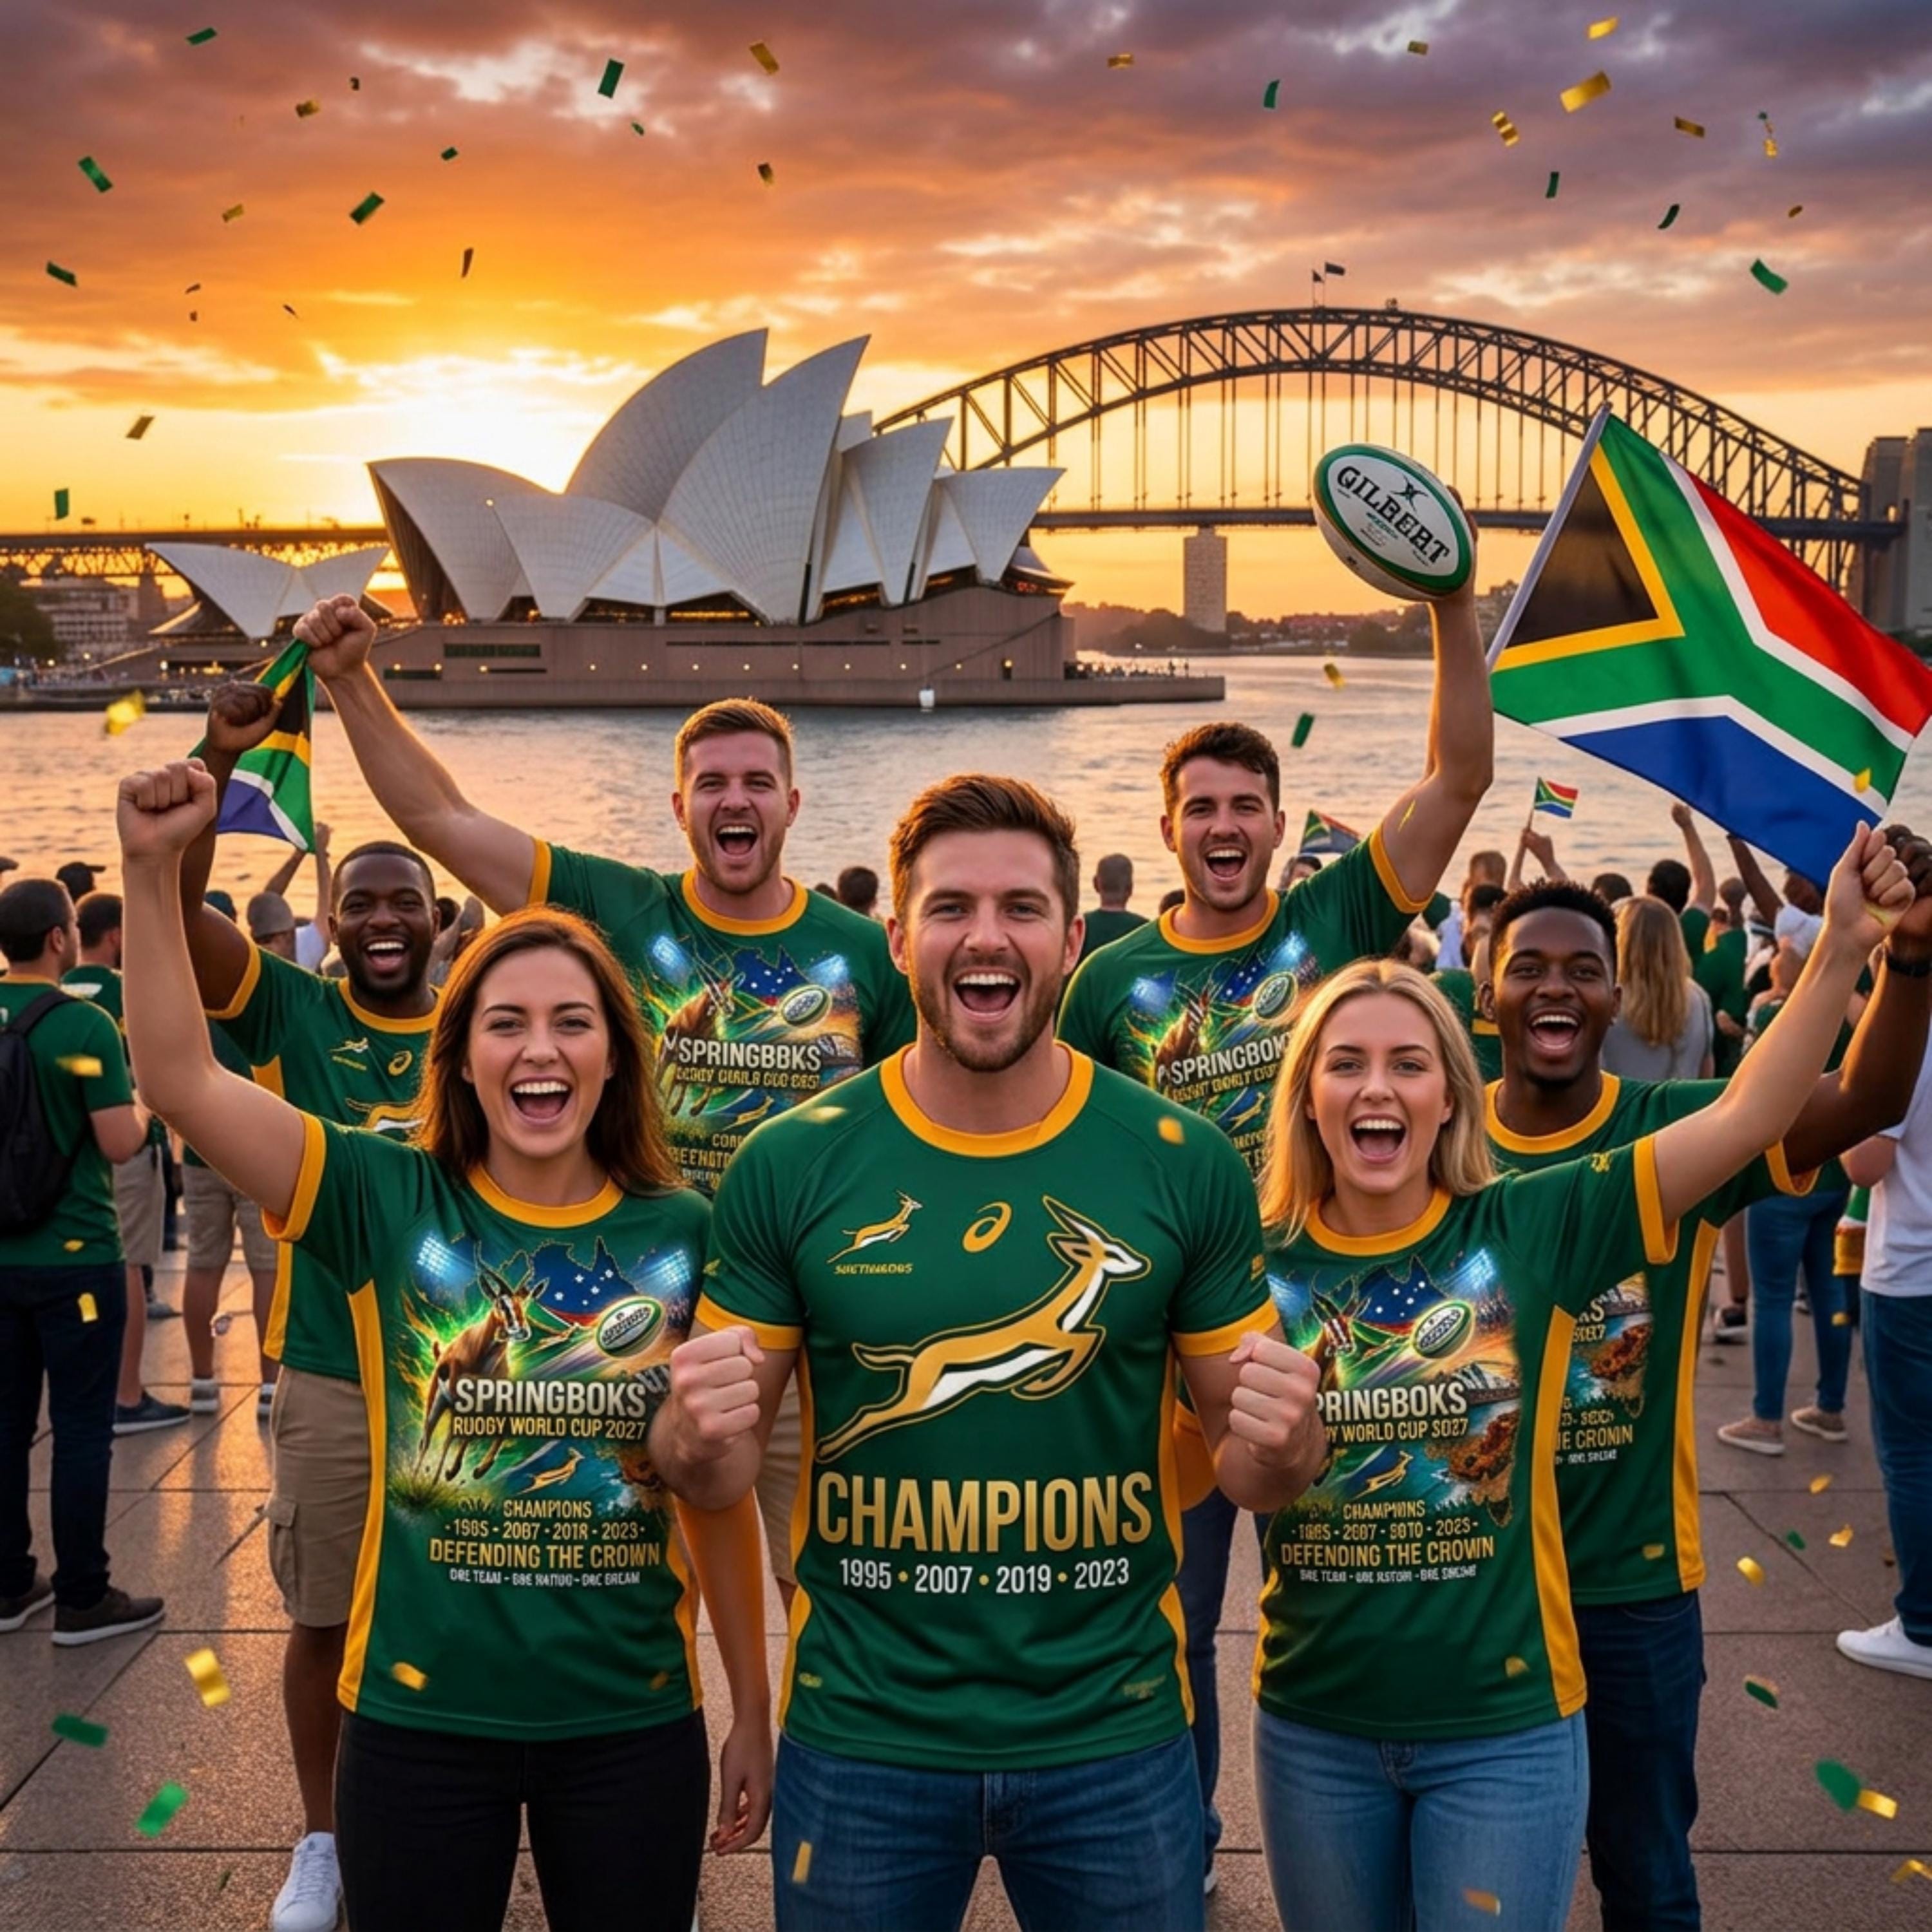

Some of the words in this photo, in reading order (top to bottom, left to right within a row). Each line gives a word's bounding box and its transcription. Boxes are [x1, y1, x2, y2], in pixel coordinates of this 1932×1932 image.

[1171, 1032, 1291, 1084] SPRINGBOK
[455, 1379, 646, 1417] SPRINGBOKS
[1316, 1381, 1467, 1422] PRINGBOKS
[510, 1417, 565, 1437] WORLD
[571, 1419, 602, 1437] CUP
[605, 1420, 646, 1439] 2027
[1341, 1423, 1394, 1443] WORLD
[1397, 1420, 1428, 1440] CUP
[817, 1472, 1152, 1553] CHAMPIONS
[430, 1537, 541, 1569] DEFENDING
[546, 1544, 584, 1569] THE
[589, 1542, 659, 1569] CROWN
[1281, 1543, 1381, 1567] DEFENDING
[1385, 1542, 1422, 1566] THE
[840, 1558, 892, 1589] 1995
[914, 1565, 973, 1593] 2007
[996, 1564, 1052, 1593] 2019
[1074, 1558, 1130, 1589] 2023
